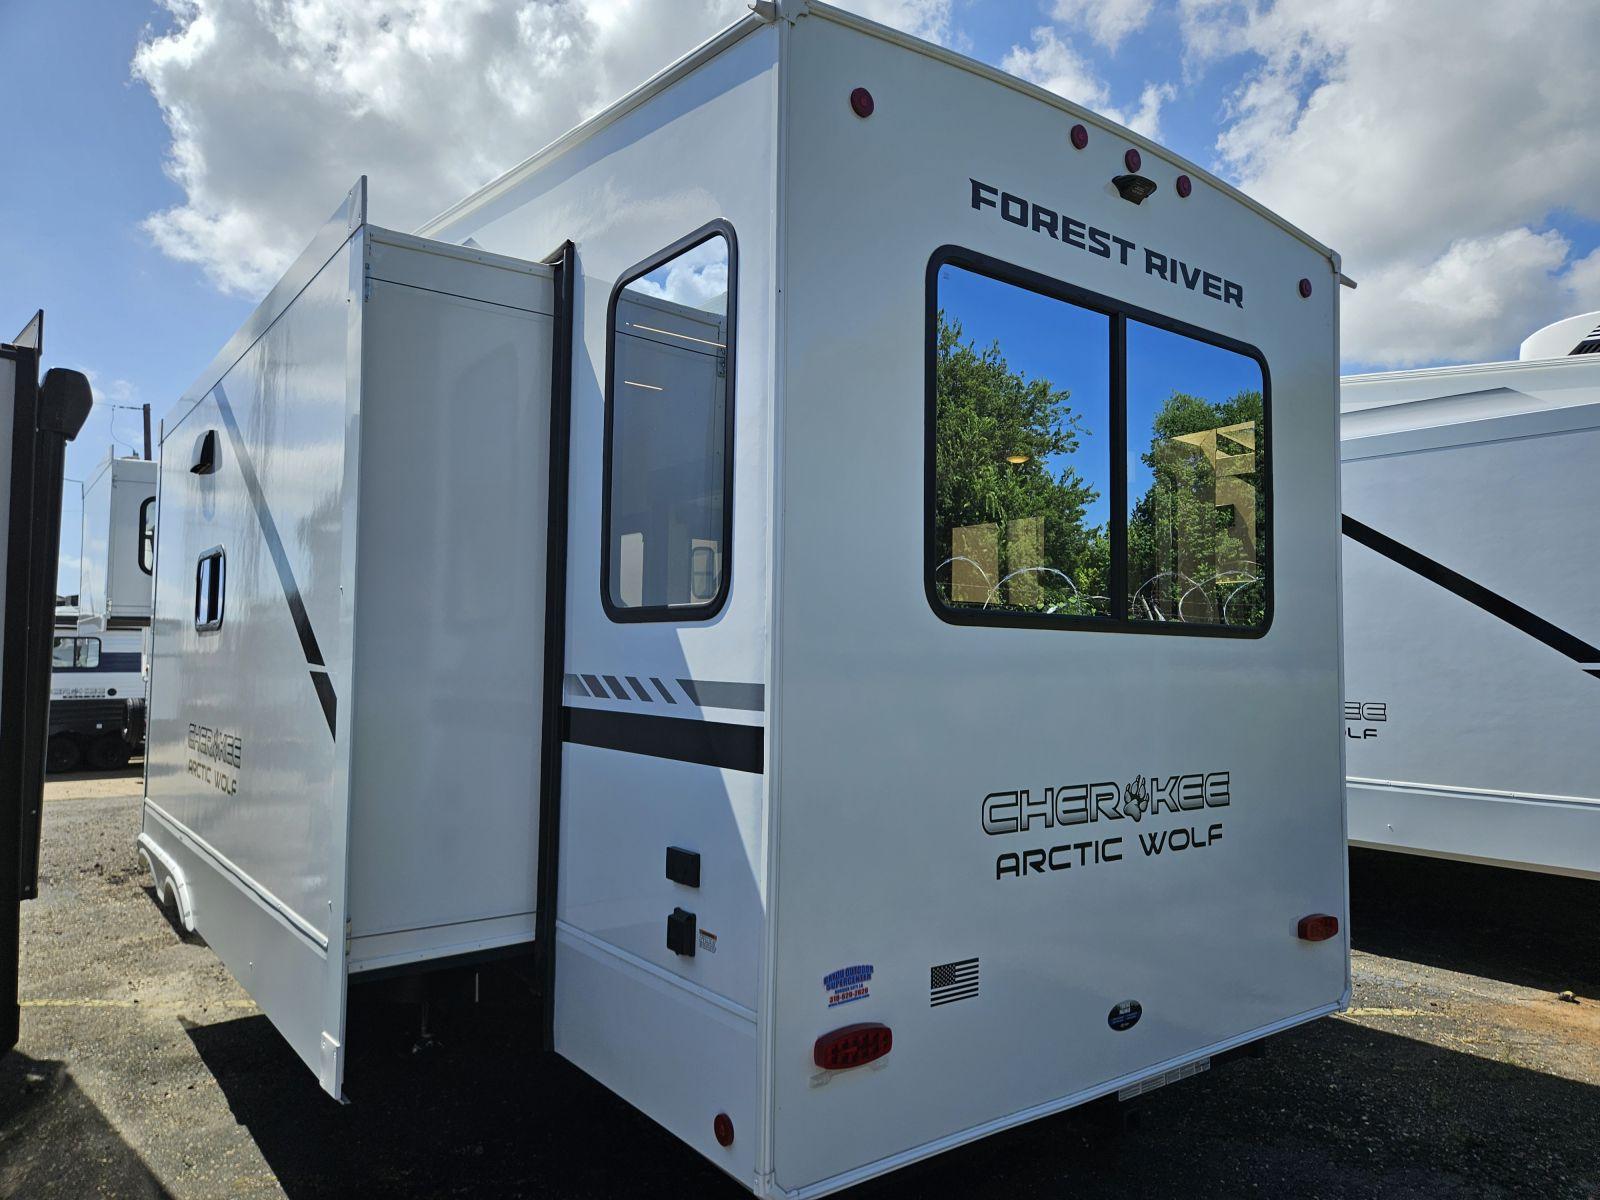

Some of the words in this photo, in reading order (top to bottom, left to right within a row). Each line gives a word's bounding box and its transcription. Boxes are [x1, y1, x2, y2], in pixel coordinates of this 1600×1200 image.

[968, 177, 1136, 266] FOREST
[1143, 247, 1244, 309] RIVER
[1345, 727, 1377, 739] LF
[214, 769, 237, 796] WOLF
[996, 837, 1122, 880] ARCTIC
[1138, 823, 1222, 856] WOLF
